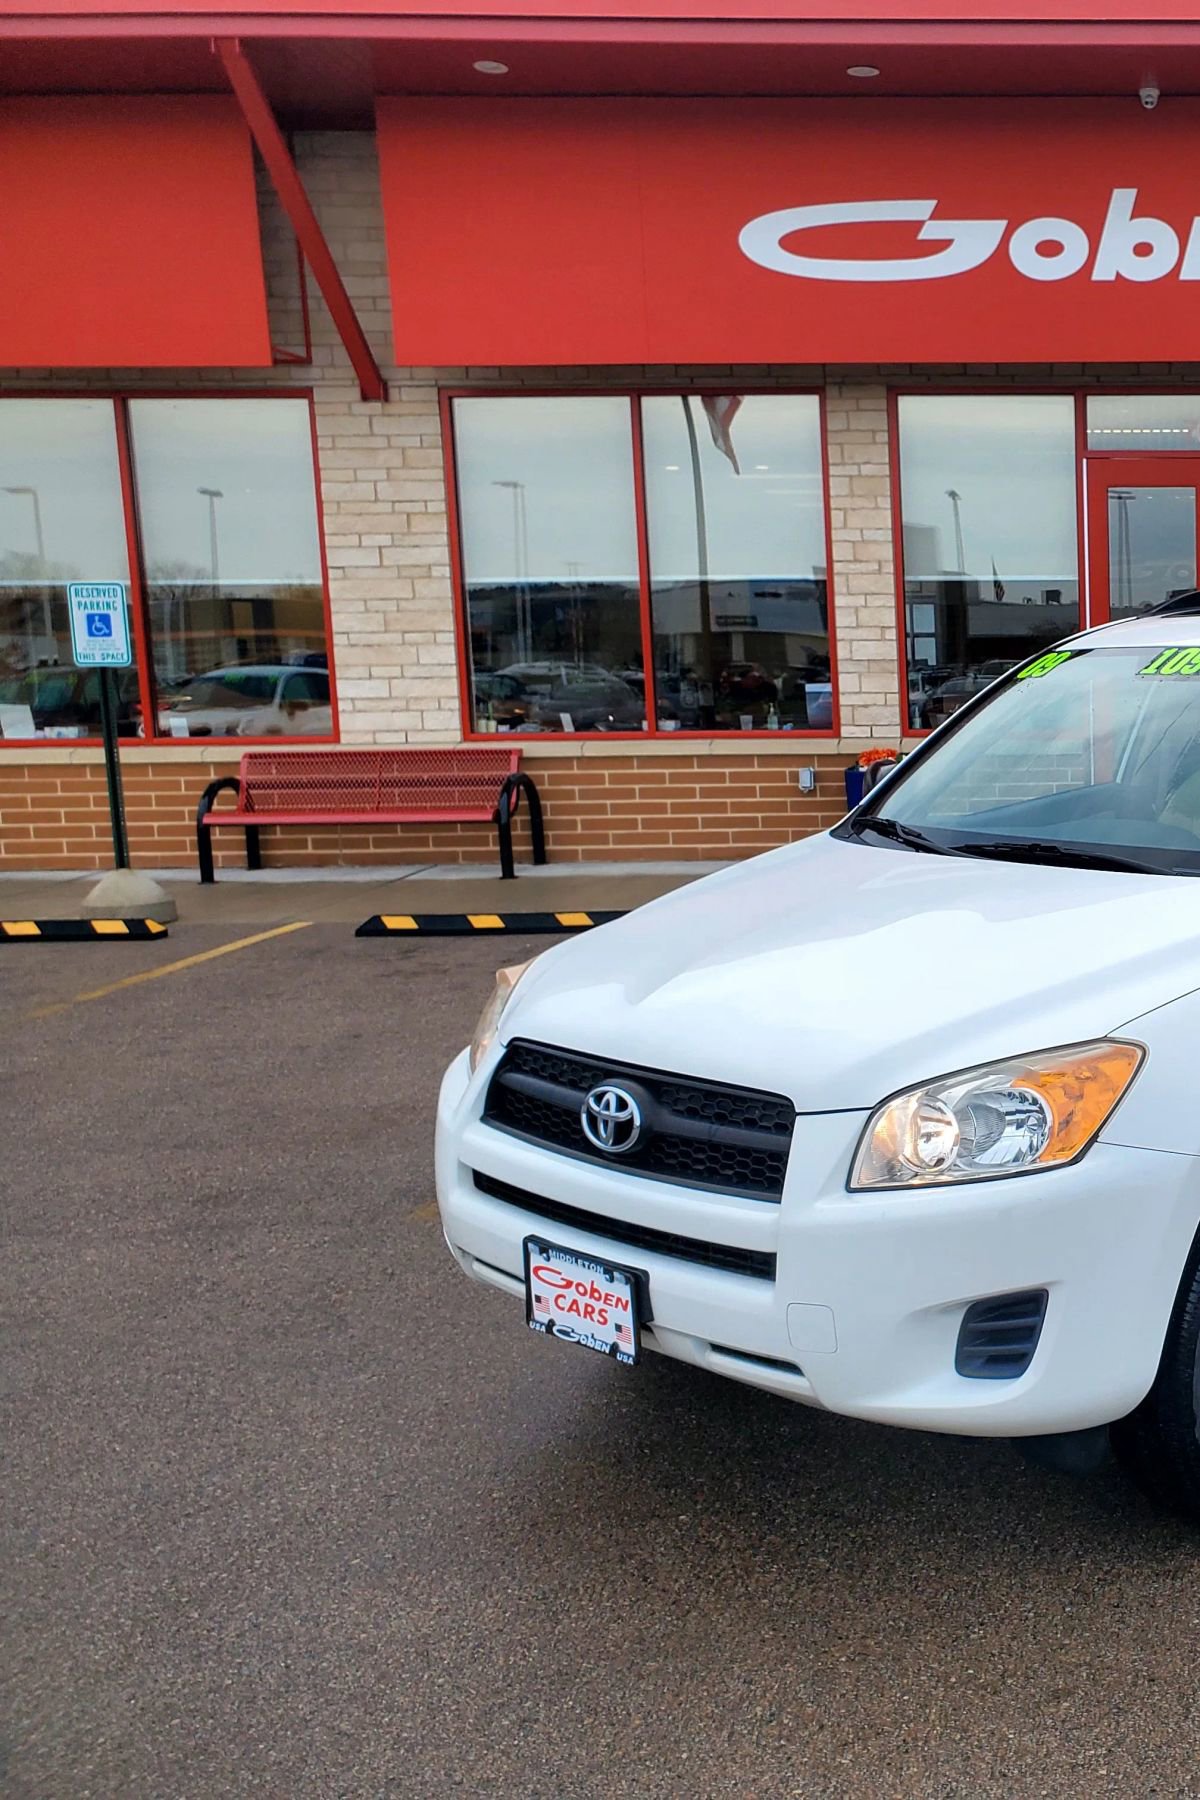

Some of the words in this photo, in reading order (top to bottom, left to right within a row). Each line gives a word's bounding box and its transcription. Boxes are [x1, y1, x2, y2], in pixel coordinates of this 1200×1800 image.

[74, 587, 119, 599] RESERVED
[77, 600, 118, 612] PARKING
[79, 652, 97, 661] THIS
[101, 652, 126, 661] SPACE
[548, 1249, 605, 1275] MIDDLETON
[553, 1293, 609, 1327] CARS
[529, 1320, 547, 1333] USA
[616, 1352, 635, 1365] USA
